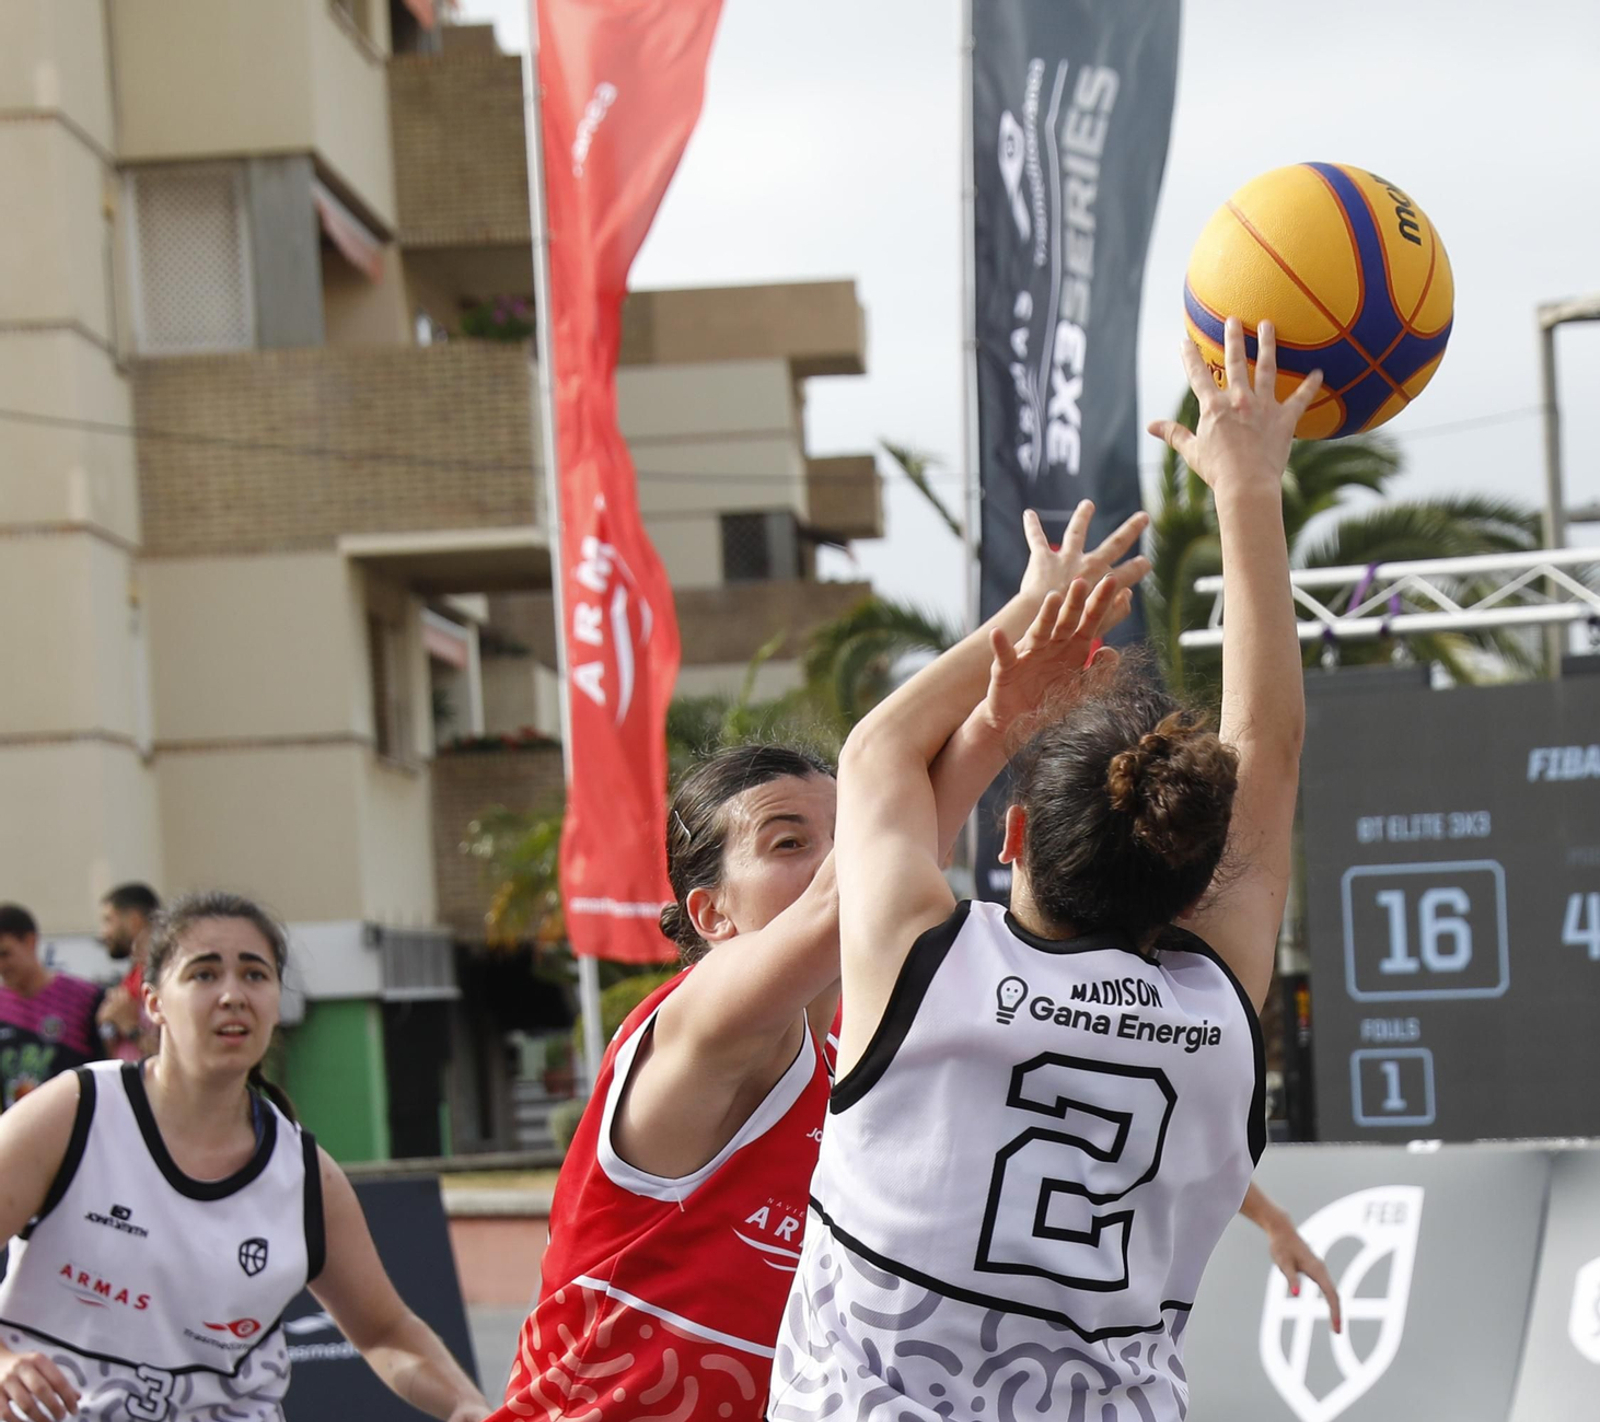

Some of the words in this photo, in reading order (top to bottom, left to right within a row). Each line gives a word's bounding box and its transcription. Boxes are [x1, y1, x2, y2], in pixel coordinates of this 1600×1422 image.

[573, 534, 615, 706] ARM
[1386, 812, 1446, 842] ELITE
[1376, 886, 1473, 976] 16
[1070, 977, 1164, 1009] MADISON
[1029, 996, 1111, 1035] Gana
[1116, 1013, 1222, 1054] Energia
[1361, 1017, 1421, 1043] FOULS
[1379, 1060, 1408, 1111] 1
[973, 1051, 1178, 1293] 2
[744, 1205, 803, 1248] AR
[1362, 1201, 1409, 1226] FEB
[59, 1263, 151, 1311] ARMAS
